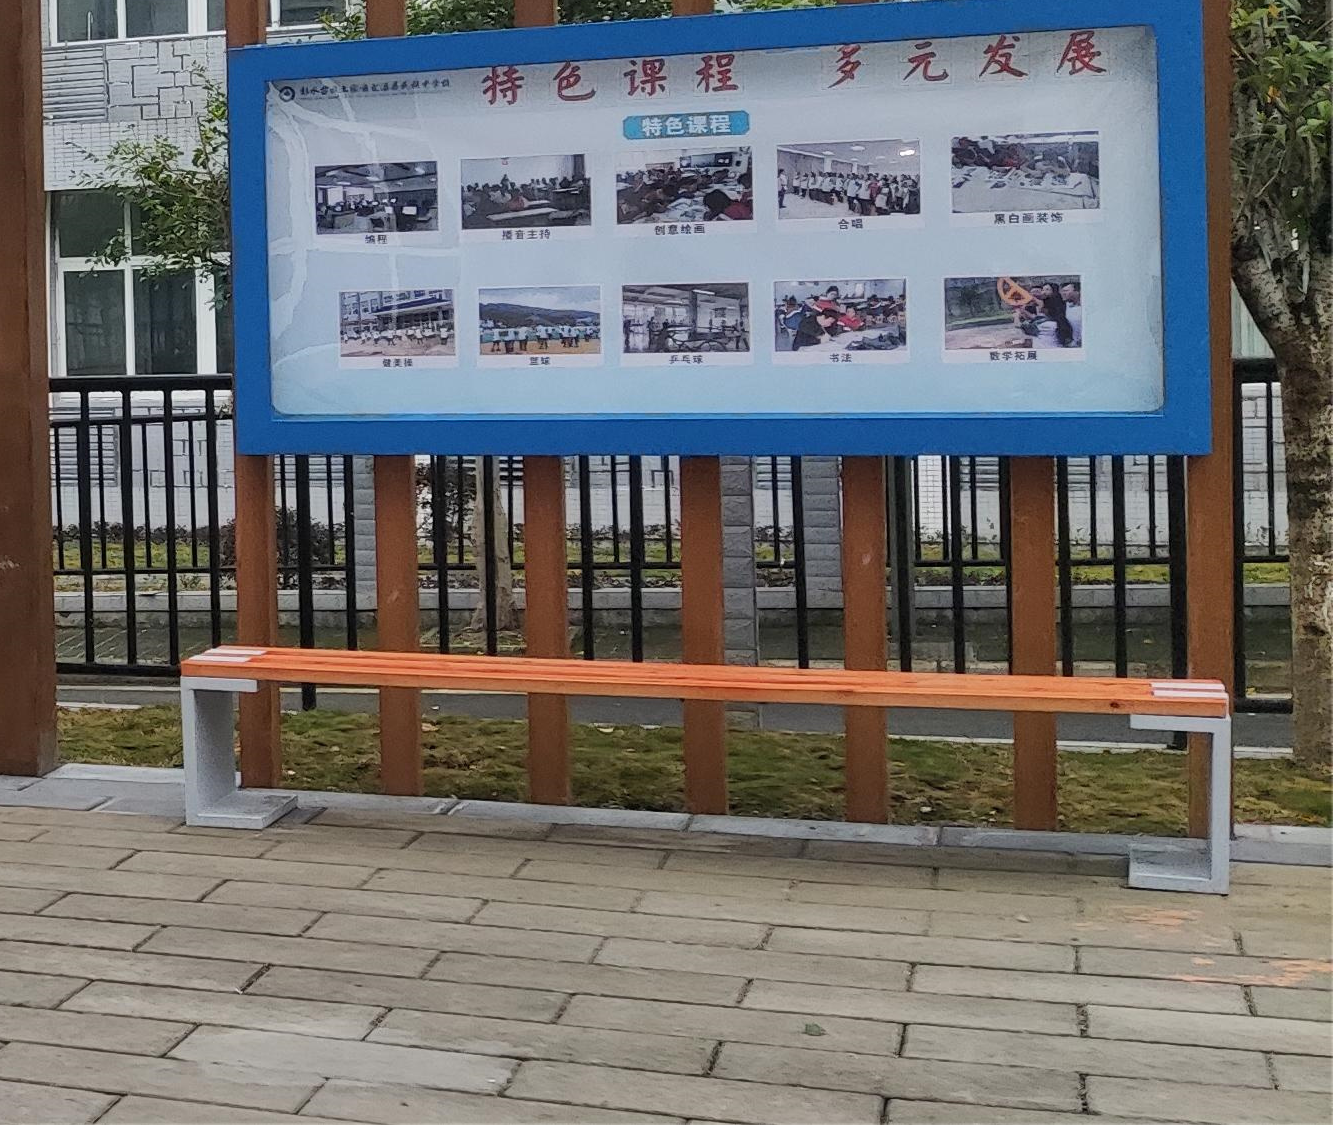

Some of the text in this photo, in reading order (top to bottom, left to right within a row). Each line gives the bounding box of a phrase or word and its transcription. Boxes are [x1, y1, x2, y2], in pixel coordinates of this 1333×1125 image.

[481, 30, 1106, 105] 特色课程 多元发展
[642, 114, 732, 136] 特色课程
[838, 218, 864, 230] 合唱
[994, 212, 1065, 225] 黑白画装饰
[501, 228, 551, 240] 播音主持
[654, 224, 706, 236] 创意绘画
[365, 234, 388, 245] 编程
[382, 357, 414, 368] 健美操
[669, 354, 703, 365] 乒乓球
[829, 353, 852, 363] 书法
[989, 351, 1037, 362] 数学拓展
